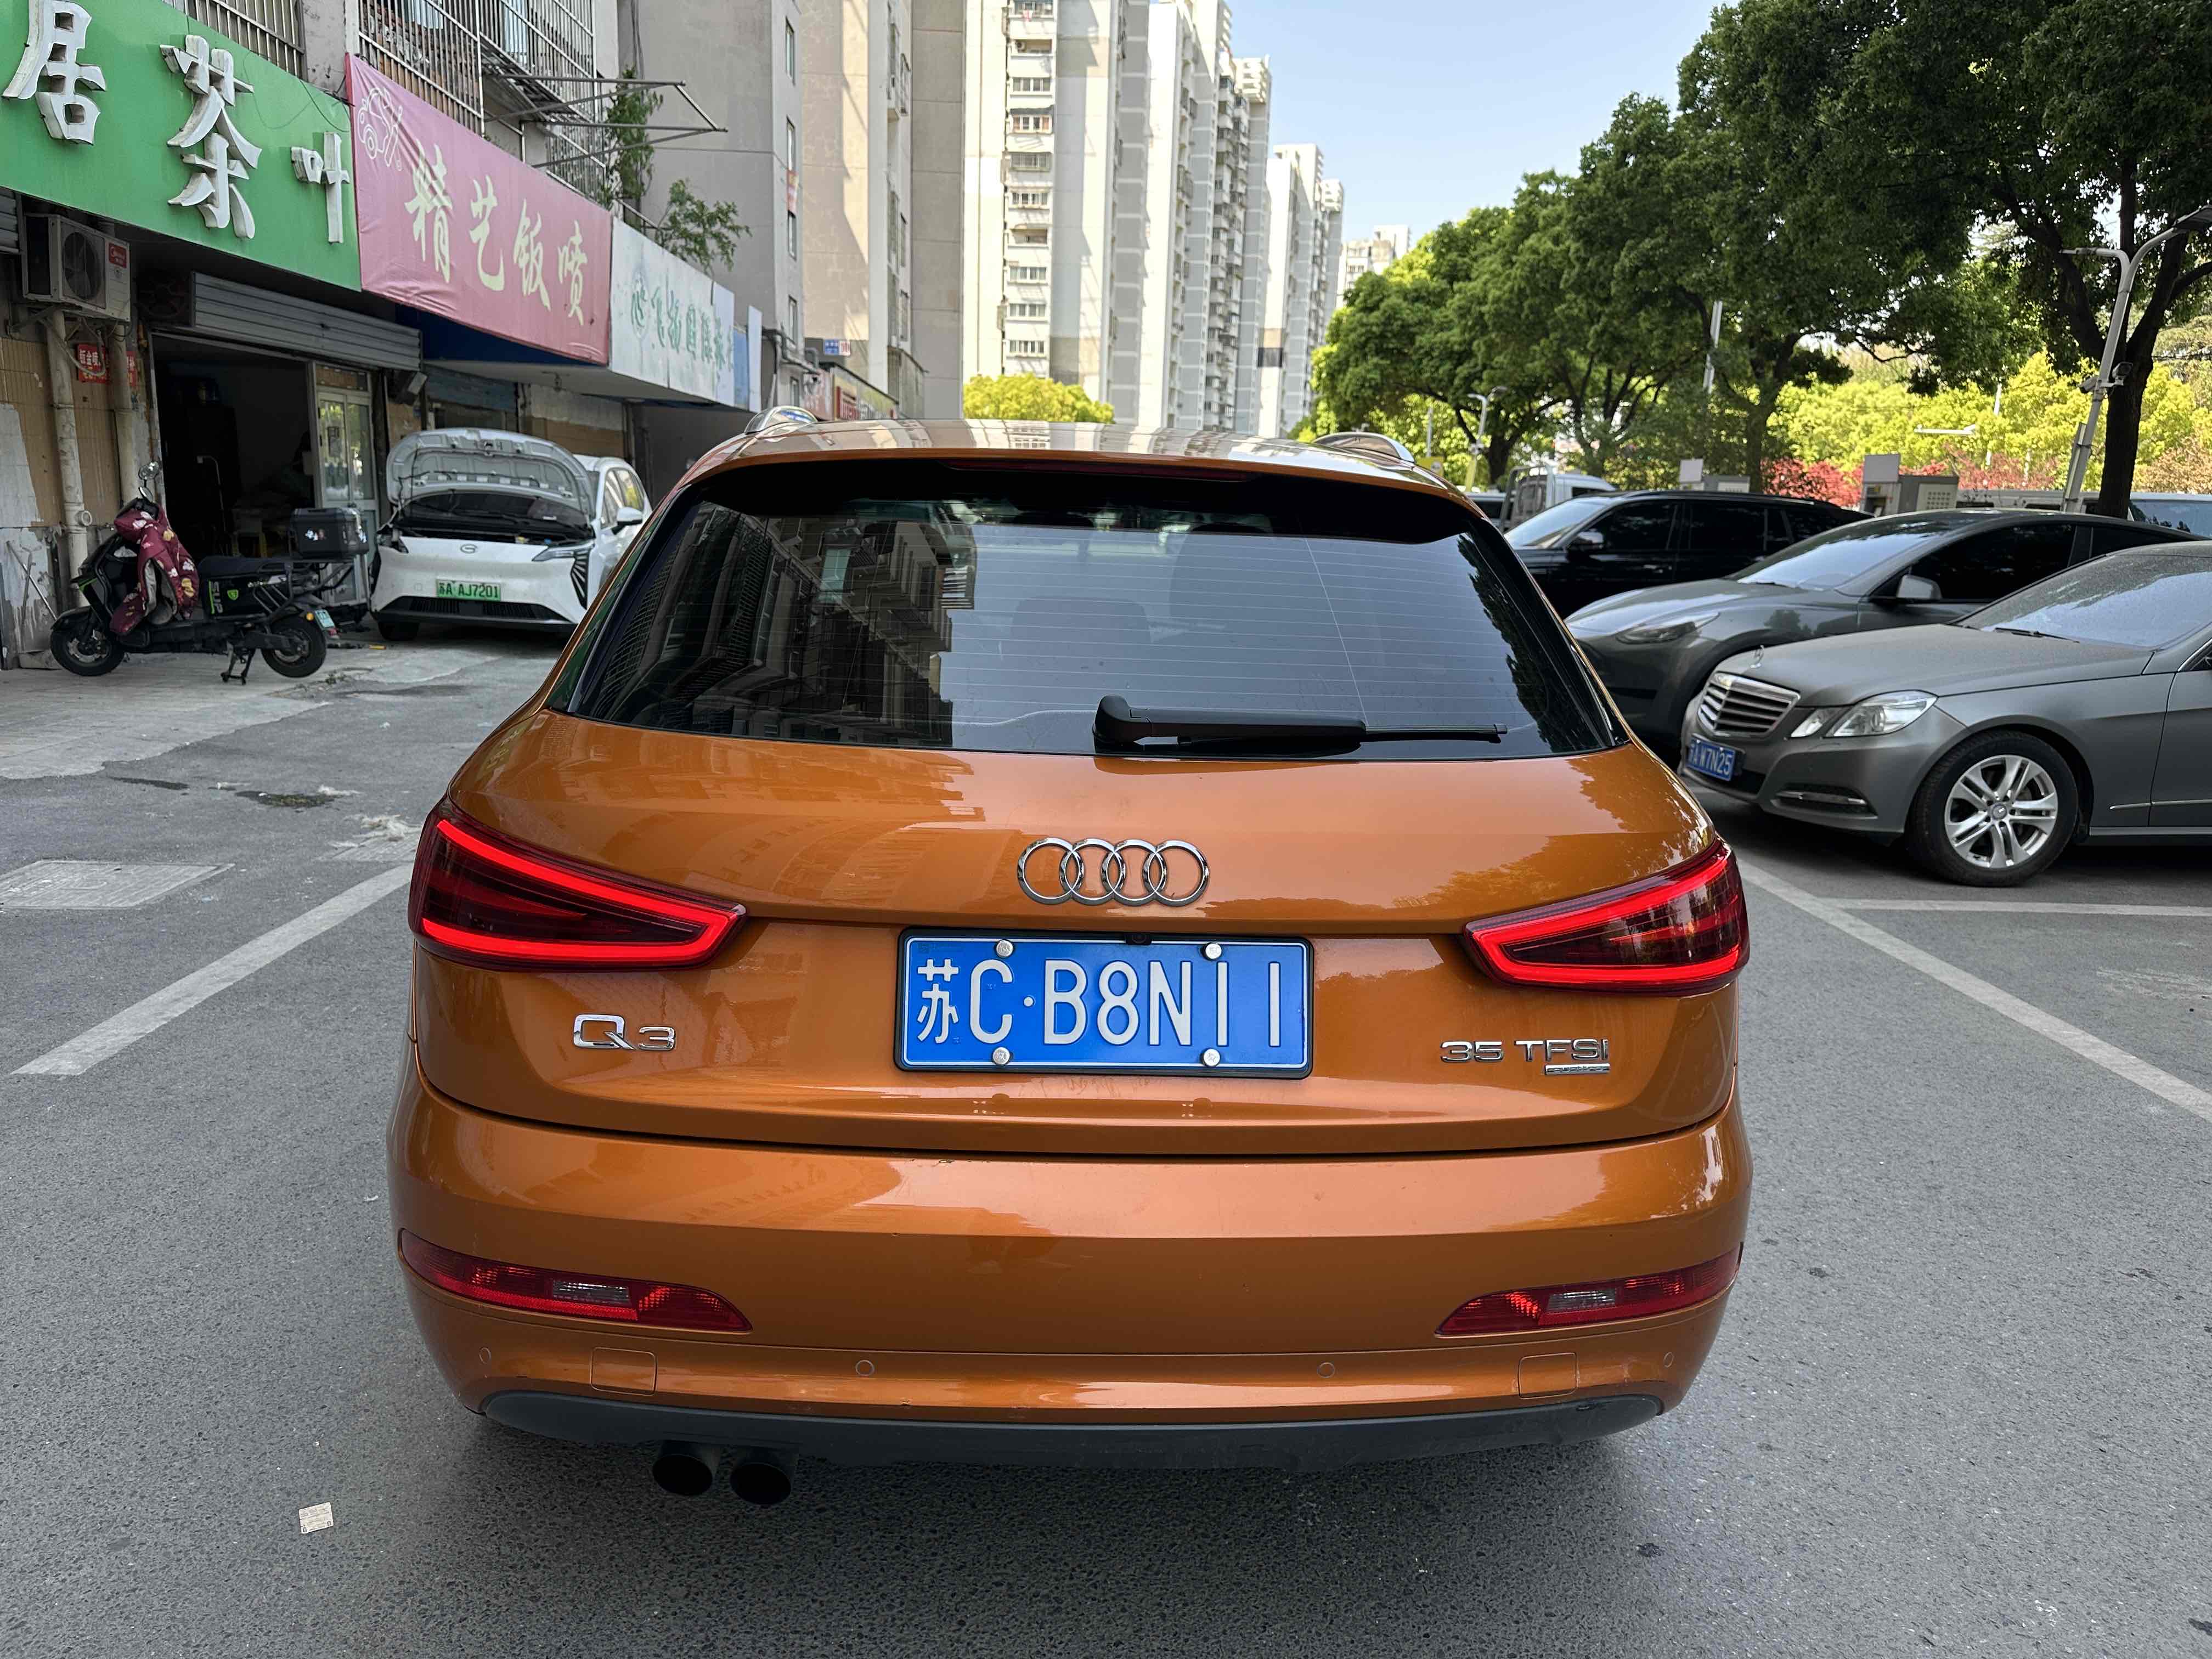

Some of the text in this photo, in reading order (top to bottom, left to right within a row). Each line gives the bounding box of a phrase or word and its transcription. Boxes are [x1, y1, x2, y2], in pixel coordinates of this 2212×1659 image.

[573, 1013, 676, 1051] Q3
[1441, 1039, 1609, 1062] 35 TFSI
